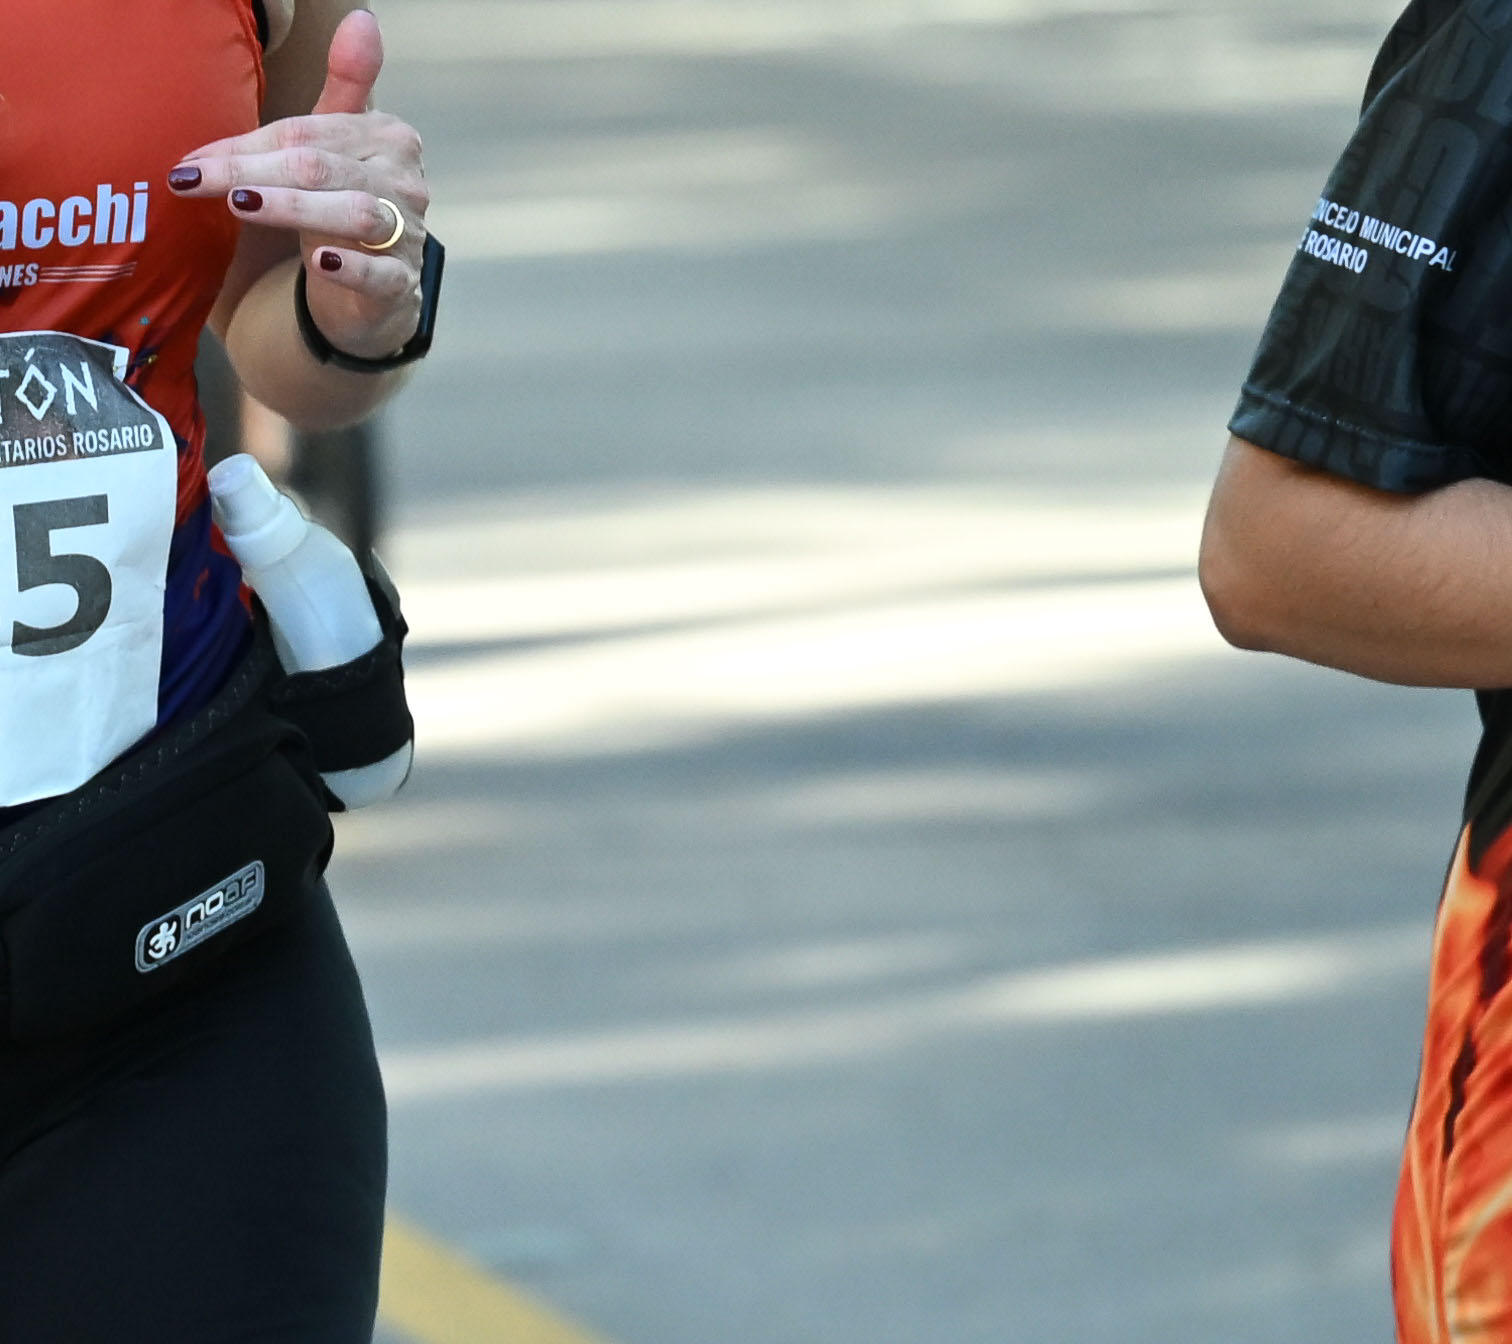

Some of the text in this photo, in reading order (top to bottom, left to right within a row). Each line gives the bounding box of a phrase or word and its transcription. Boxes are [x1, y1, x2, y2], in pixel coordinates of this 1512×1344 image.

[1303, 229, 1368, 274] ROSARIO
[1358, 214, 1457, 272] MUNICIPAL
[72, 423, 154, 454] ROSARIO
